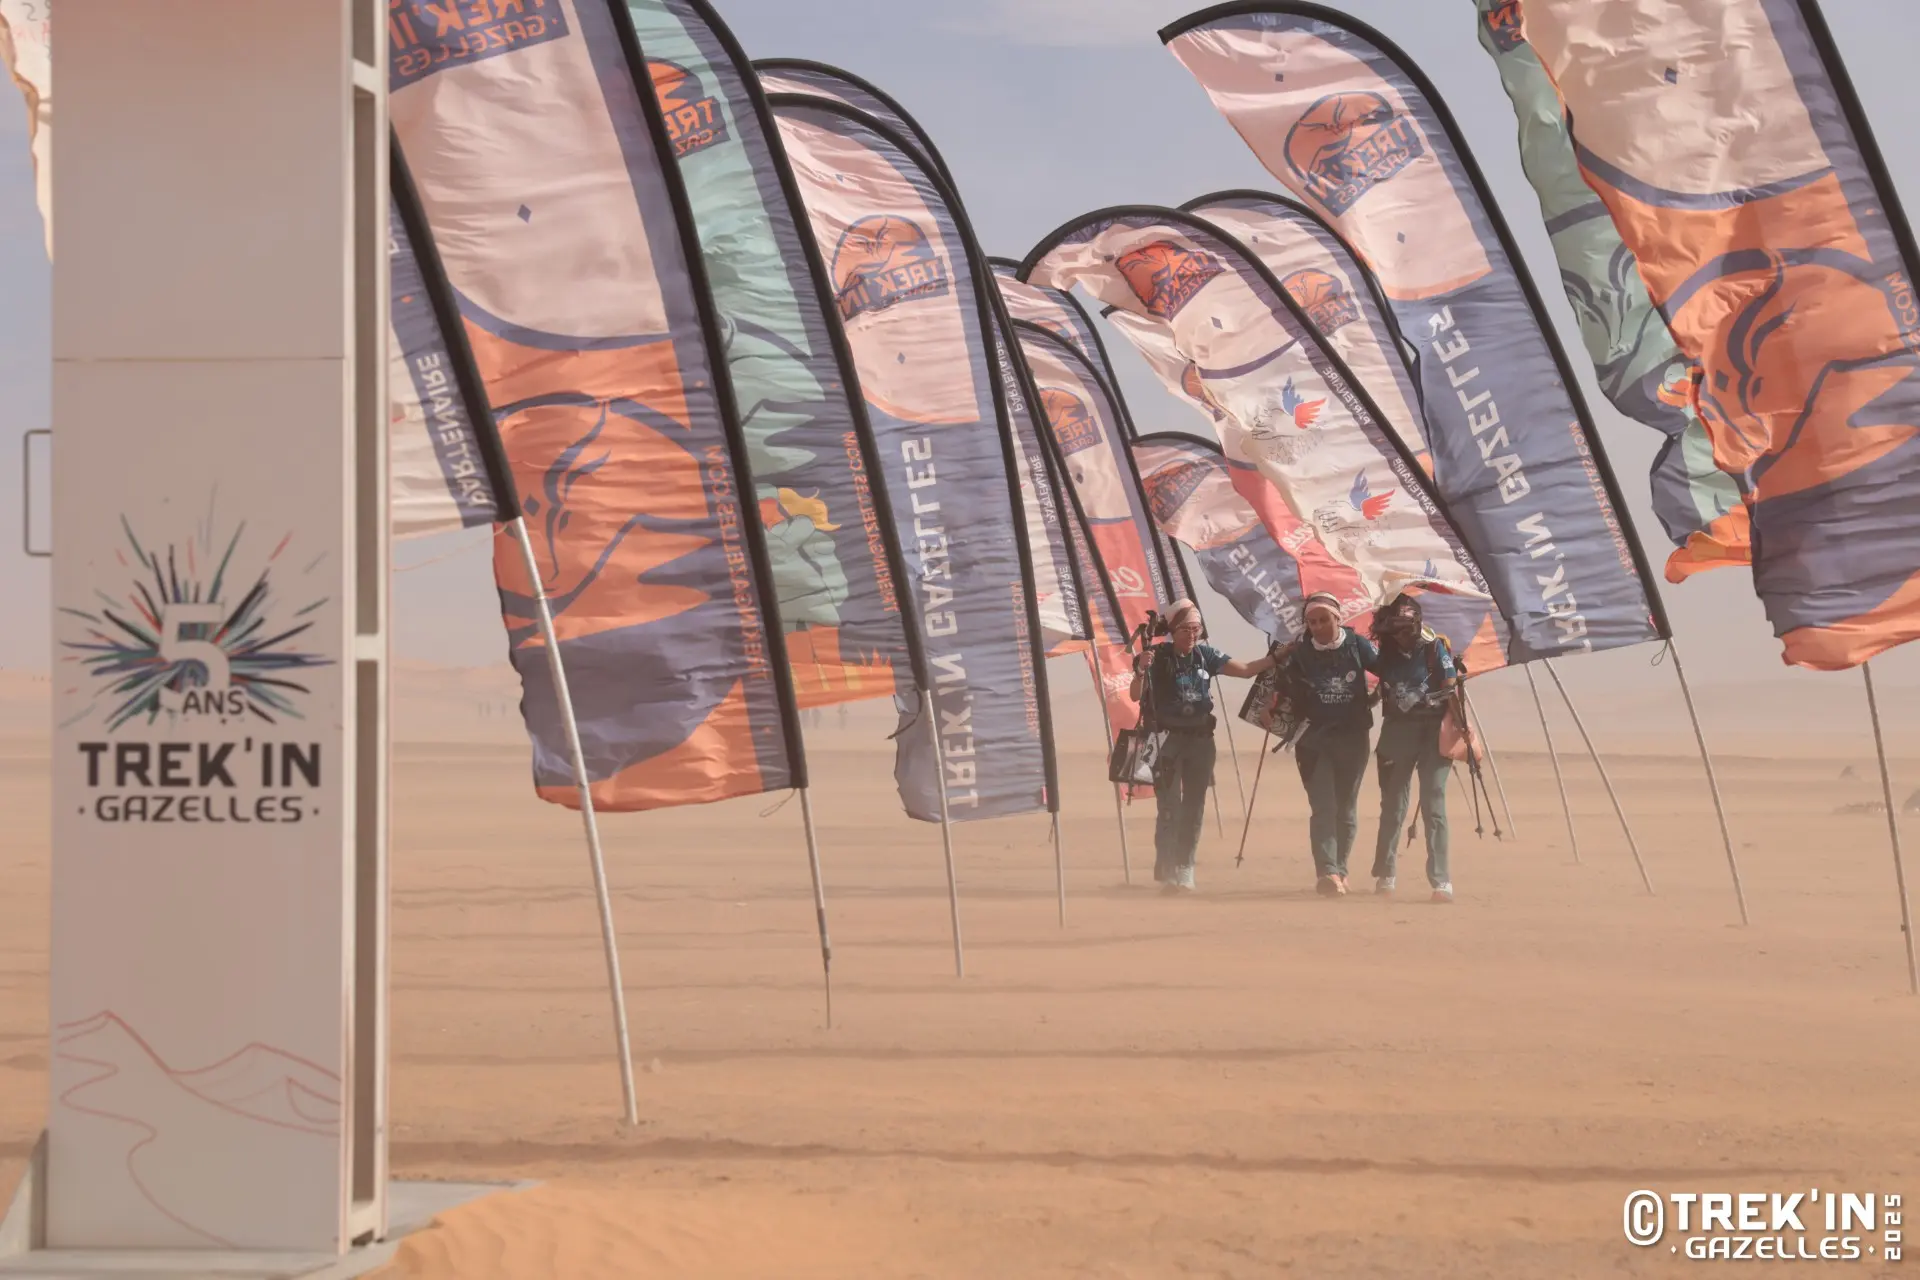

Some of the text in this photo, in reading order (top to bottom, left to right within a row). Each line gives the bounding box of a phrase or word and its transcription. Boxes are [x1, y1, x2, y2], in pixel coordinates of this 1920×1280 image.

[182, 690, 245, 715] ANS
[78, 736, 321, 787] TREK'IN
[95, 795, 302, 823] GAZELLES
